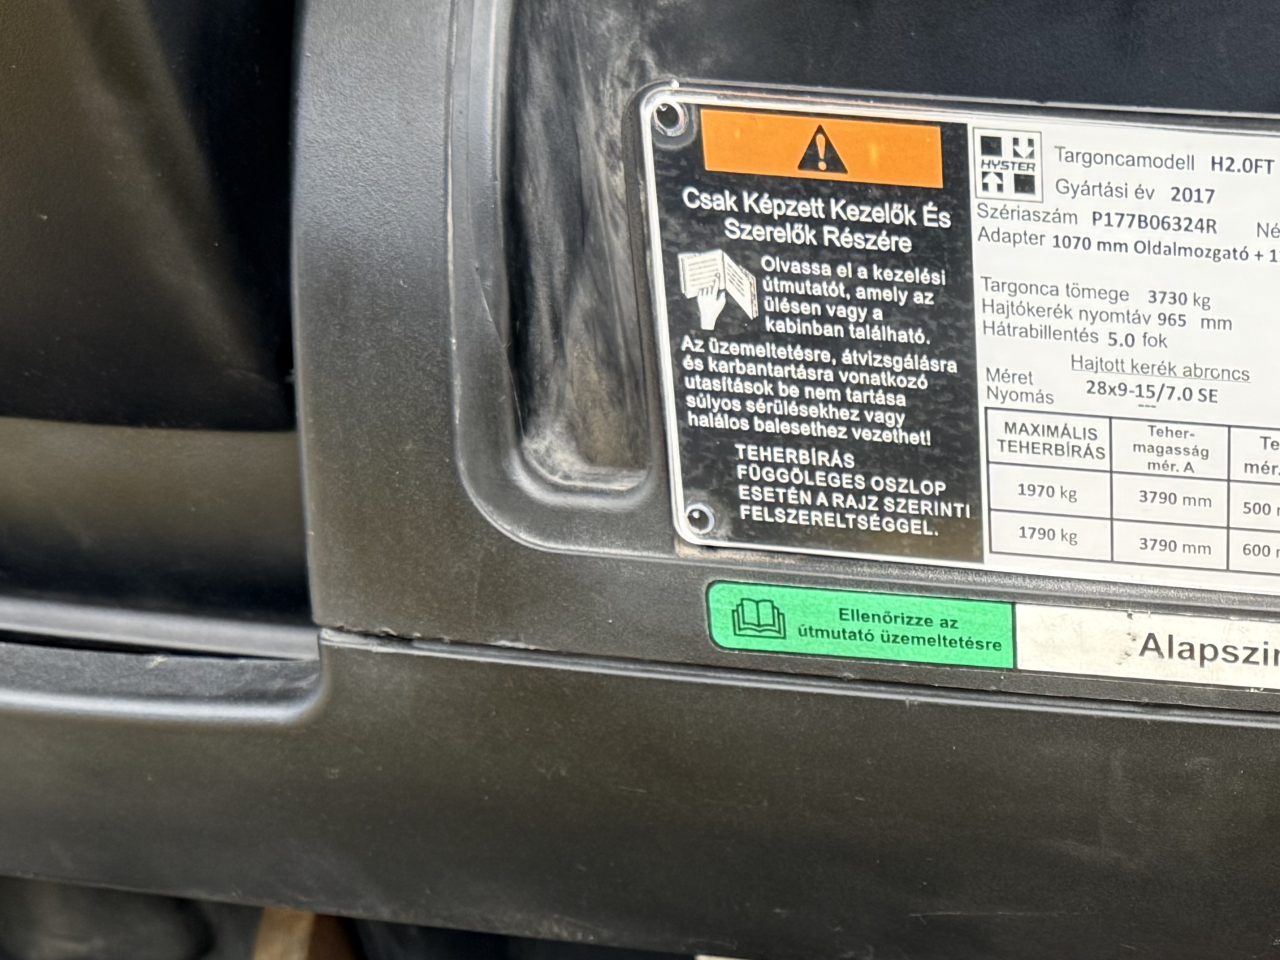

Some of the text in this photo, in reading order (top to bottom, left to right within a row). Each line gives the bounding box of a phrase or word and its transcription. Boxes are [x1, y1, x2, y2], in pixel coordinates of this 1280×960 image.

[981, 159, 1036, 172] HYSTER
[1054, 146, 1275, 175] Targoncamodell H2.0FT
[1055, 178, 1216, 204] Gyártási év 2017
[682, 187, 951, 228] Csak Képzett Kezelők És
[976, 203, 1218, 235] Szériaszám P177B06324R
[724, 217, 912, 253] Szerelők Részére
[977, 227, 1046, 248] Adapter
[1052, 235, 1091, 251] 1070
[1097, 241, 1129, 253] mm
[1134, 240, 1249, 263] Oldalmozgató
[761, 255, 945, 286] Olvassa el a kezelési
[763, 277, 934, 306] útmutatót, amely az
[980, 276, 1211, 311] Targonca tömege 3730 kg
[764, 297, 883, 321] ülésen vagy a
[982, 299, 1233, 331] Hajtókerék nyomtáv 965 mm
[765, 317, 930, 345] kabinban található.
[983, 320, 1168, 348] Hátrabillentés 5.0 fok
[681, 335, 957, 374] Az üzemeltetésre, átvizsgálásra
[683, 355, 928, 390] és karbantartásra vonatkozó
[986, 367, 1033, 386] Méret
[1070, 354, 1250, 382] Hajtott kerék abroncs
[684, 375, 906, 407] utasítások be nem tartása
[986, 386, 1054, 405] Nyomás
[1086, 380, 1218, 403] 28x9-15/7.0 SE
[686, 393, 905, 428] súlyos sérülésekhez vagy
[688, 411, 931, 446] halálos balesethez vezethet!
[1004, 420, 1098, 441] MAXIMÁLIS
[1148, 425, 1196, 439] Teher-
[735, 444, 855, 469] TEHERBÍRÁS
[996, 438, 1106, 460] TEHERBÍRÁS
[1132, 442, 1210, 460] magasság
[1147, 460, 1194, 473] mér. A
[871, 476, 946, 496] OSZLOP
[1018, 483, 1078, 502] 1970 kg
[1139, 490, 1212, 508] 3790 mm
[738, 484, 971, 519] ESETÉN A RAJZ SZERINTI
[1242, 502, 1271, 516] 500
[740, 504, 939, 536] FELSZERELTSÉGGEL.
[1018, 526, 1078, 546] 1790 kg
[1139, 538, 1212, 556] 3790 mm
[1241, 544, 1271, 558] 600
[838, 607, 959, 629] Ellenőrizze az
[798, 624, 1002, 651] útmutató üzemeltetésre
